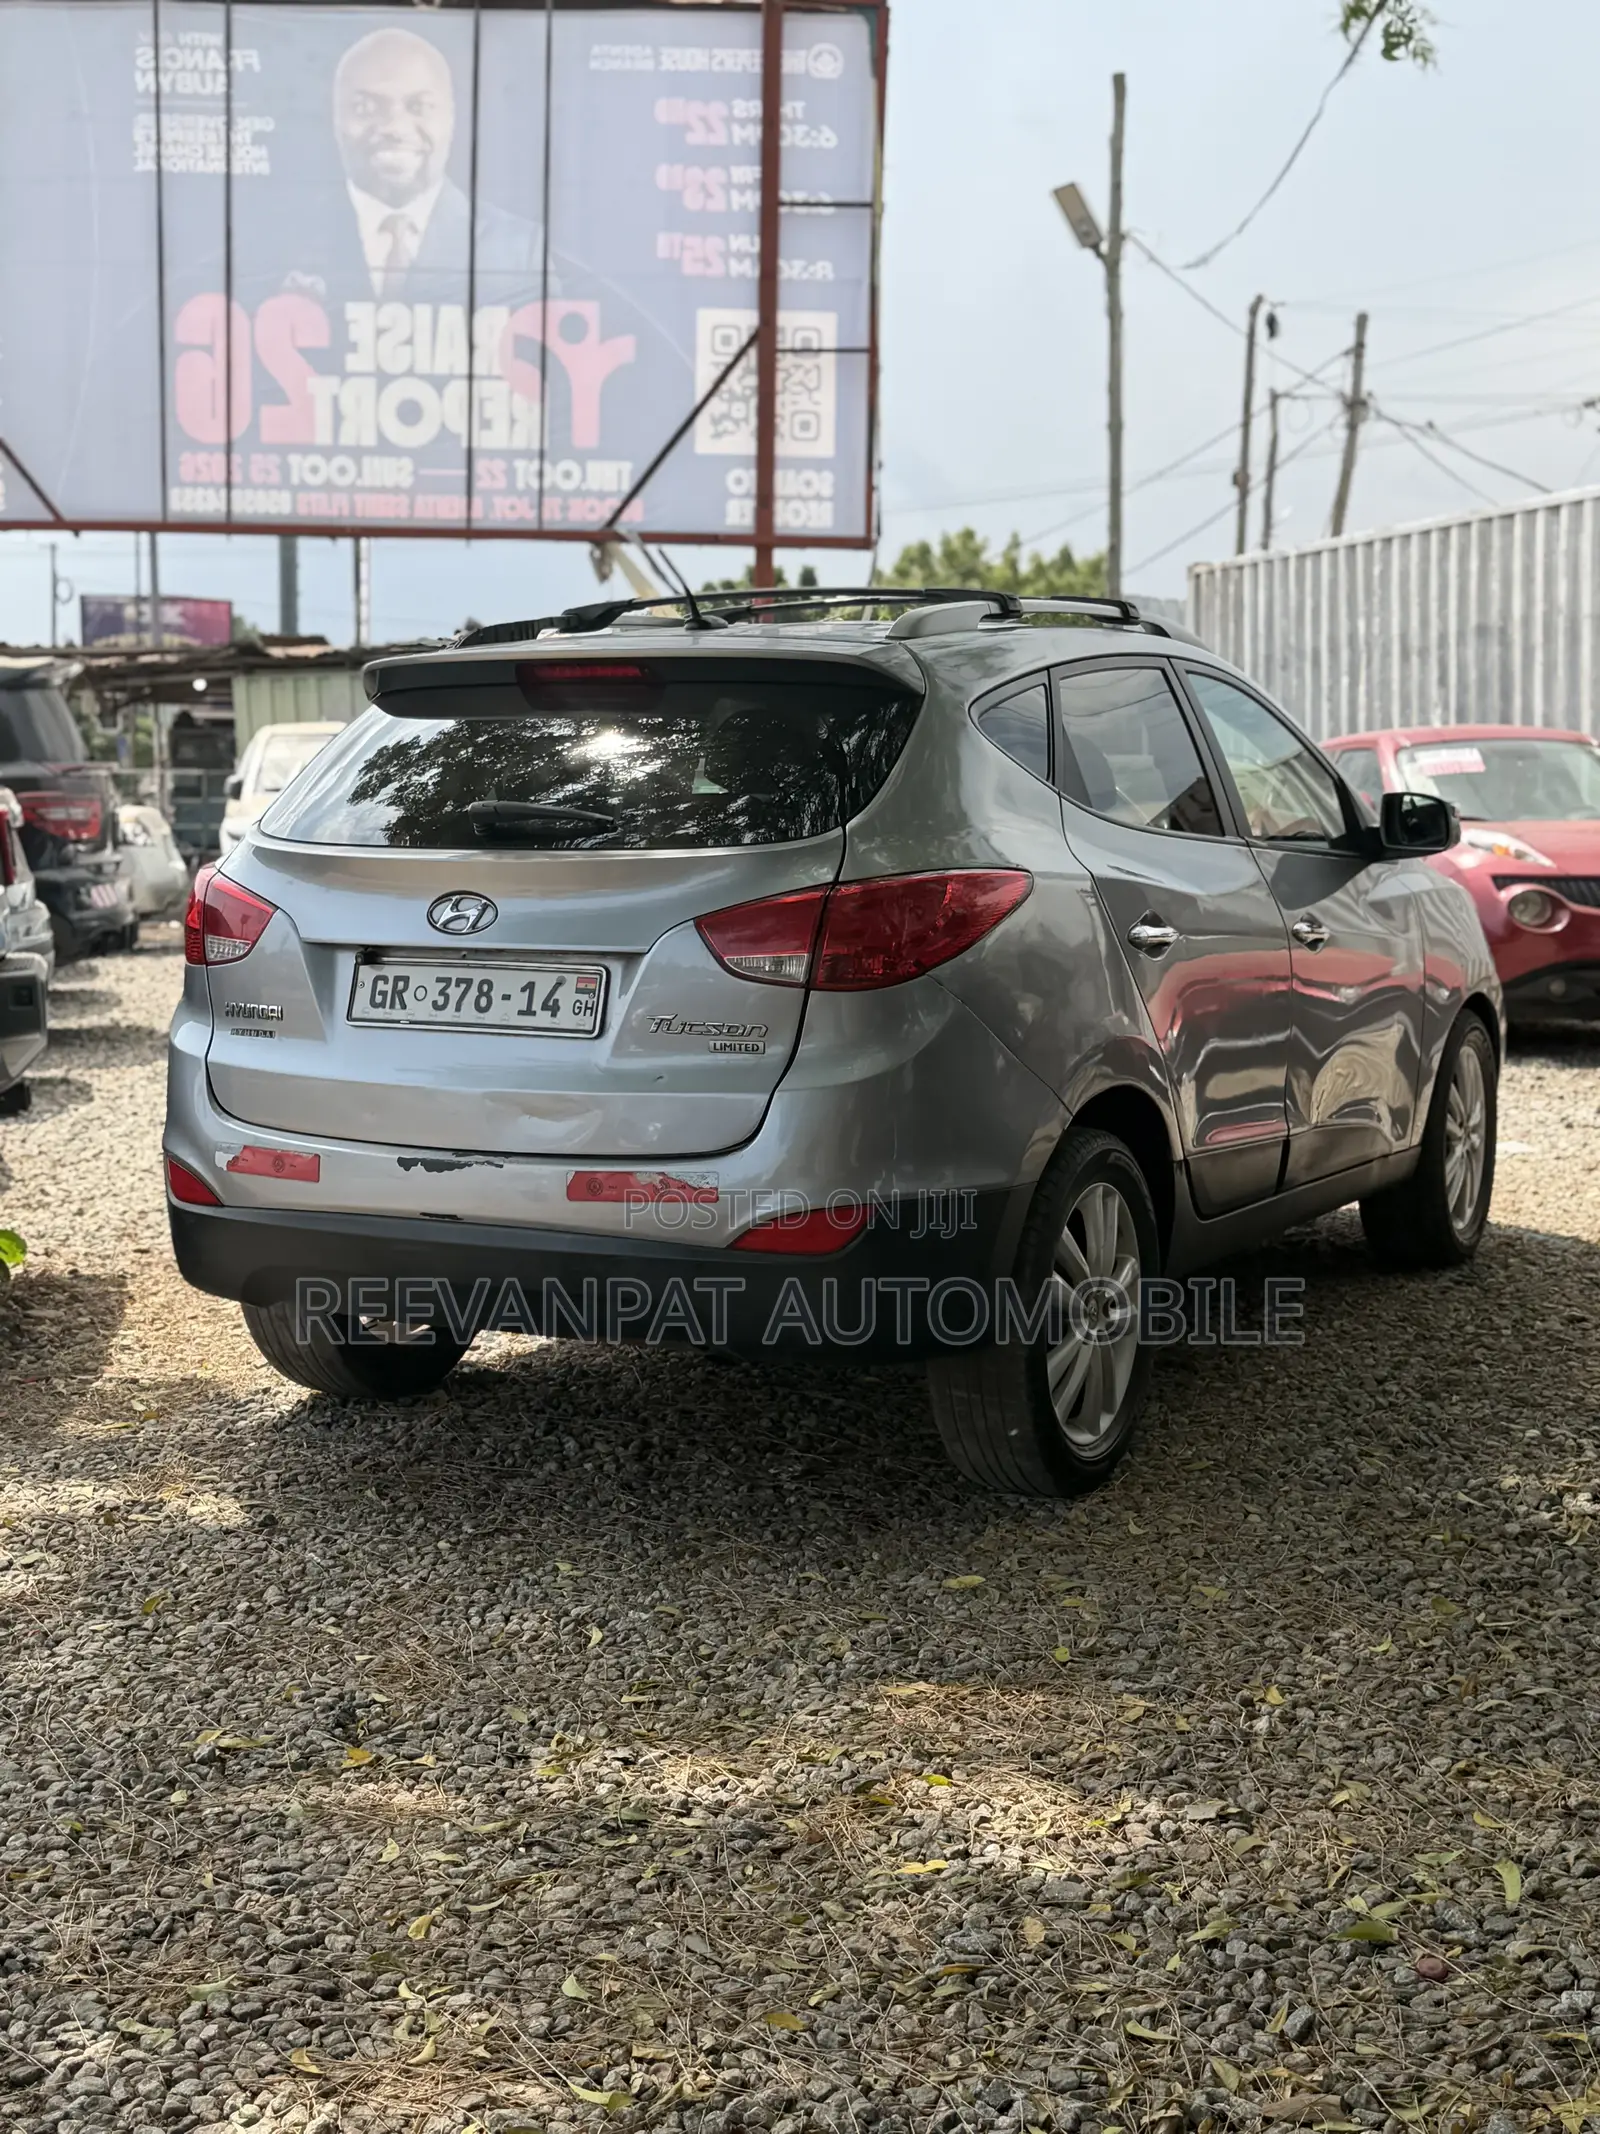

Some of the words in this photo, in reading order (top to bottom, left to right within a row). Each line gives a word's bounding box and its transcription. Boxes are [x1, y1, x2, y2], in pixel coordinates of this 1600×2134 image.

[368, 974, 411, 1011] GR
[571, 998, 595, 1018] GH
[713, 1041, 761, 1053] LIMITED
